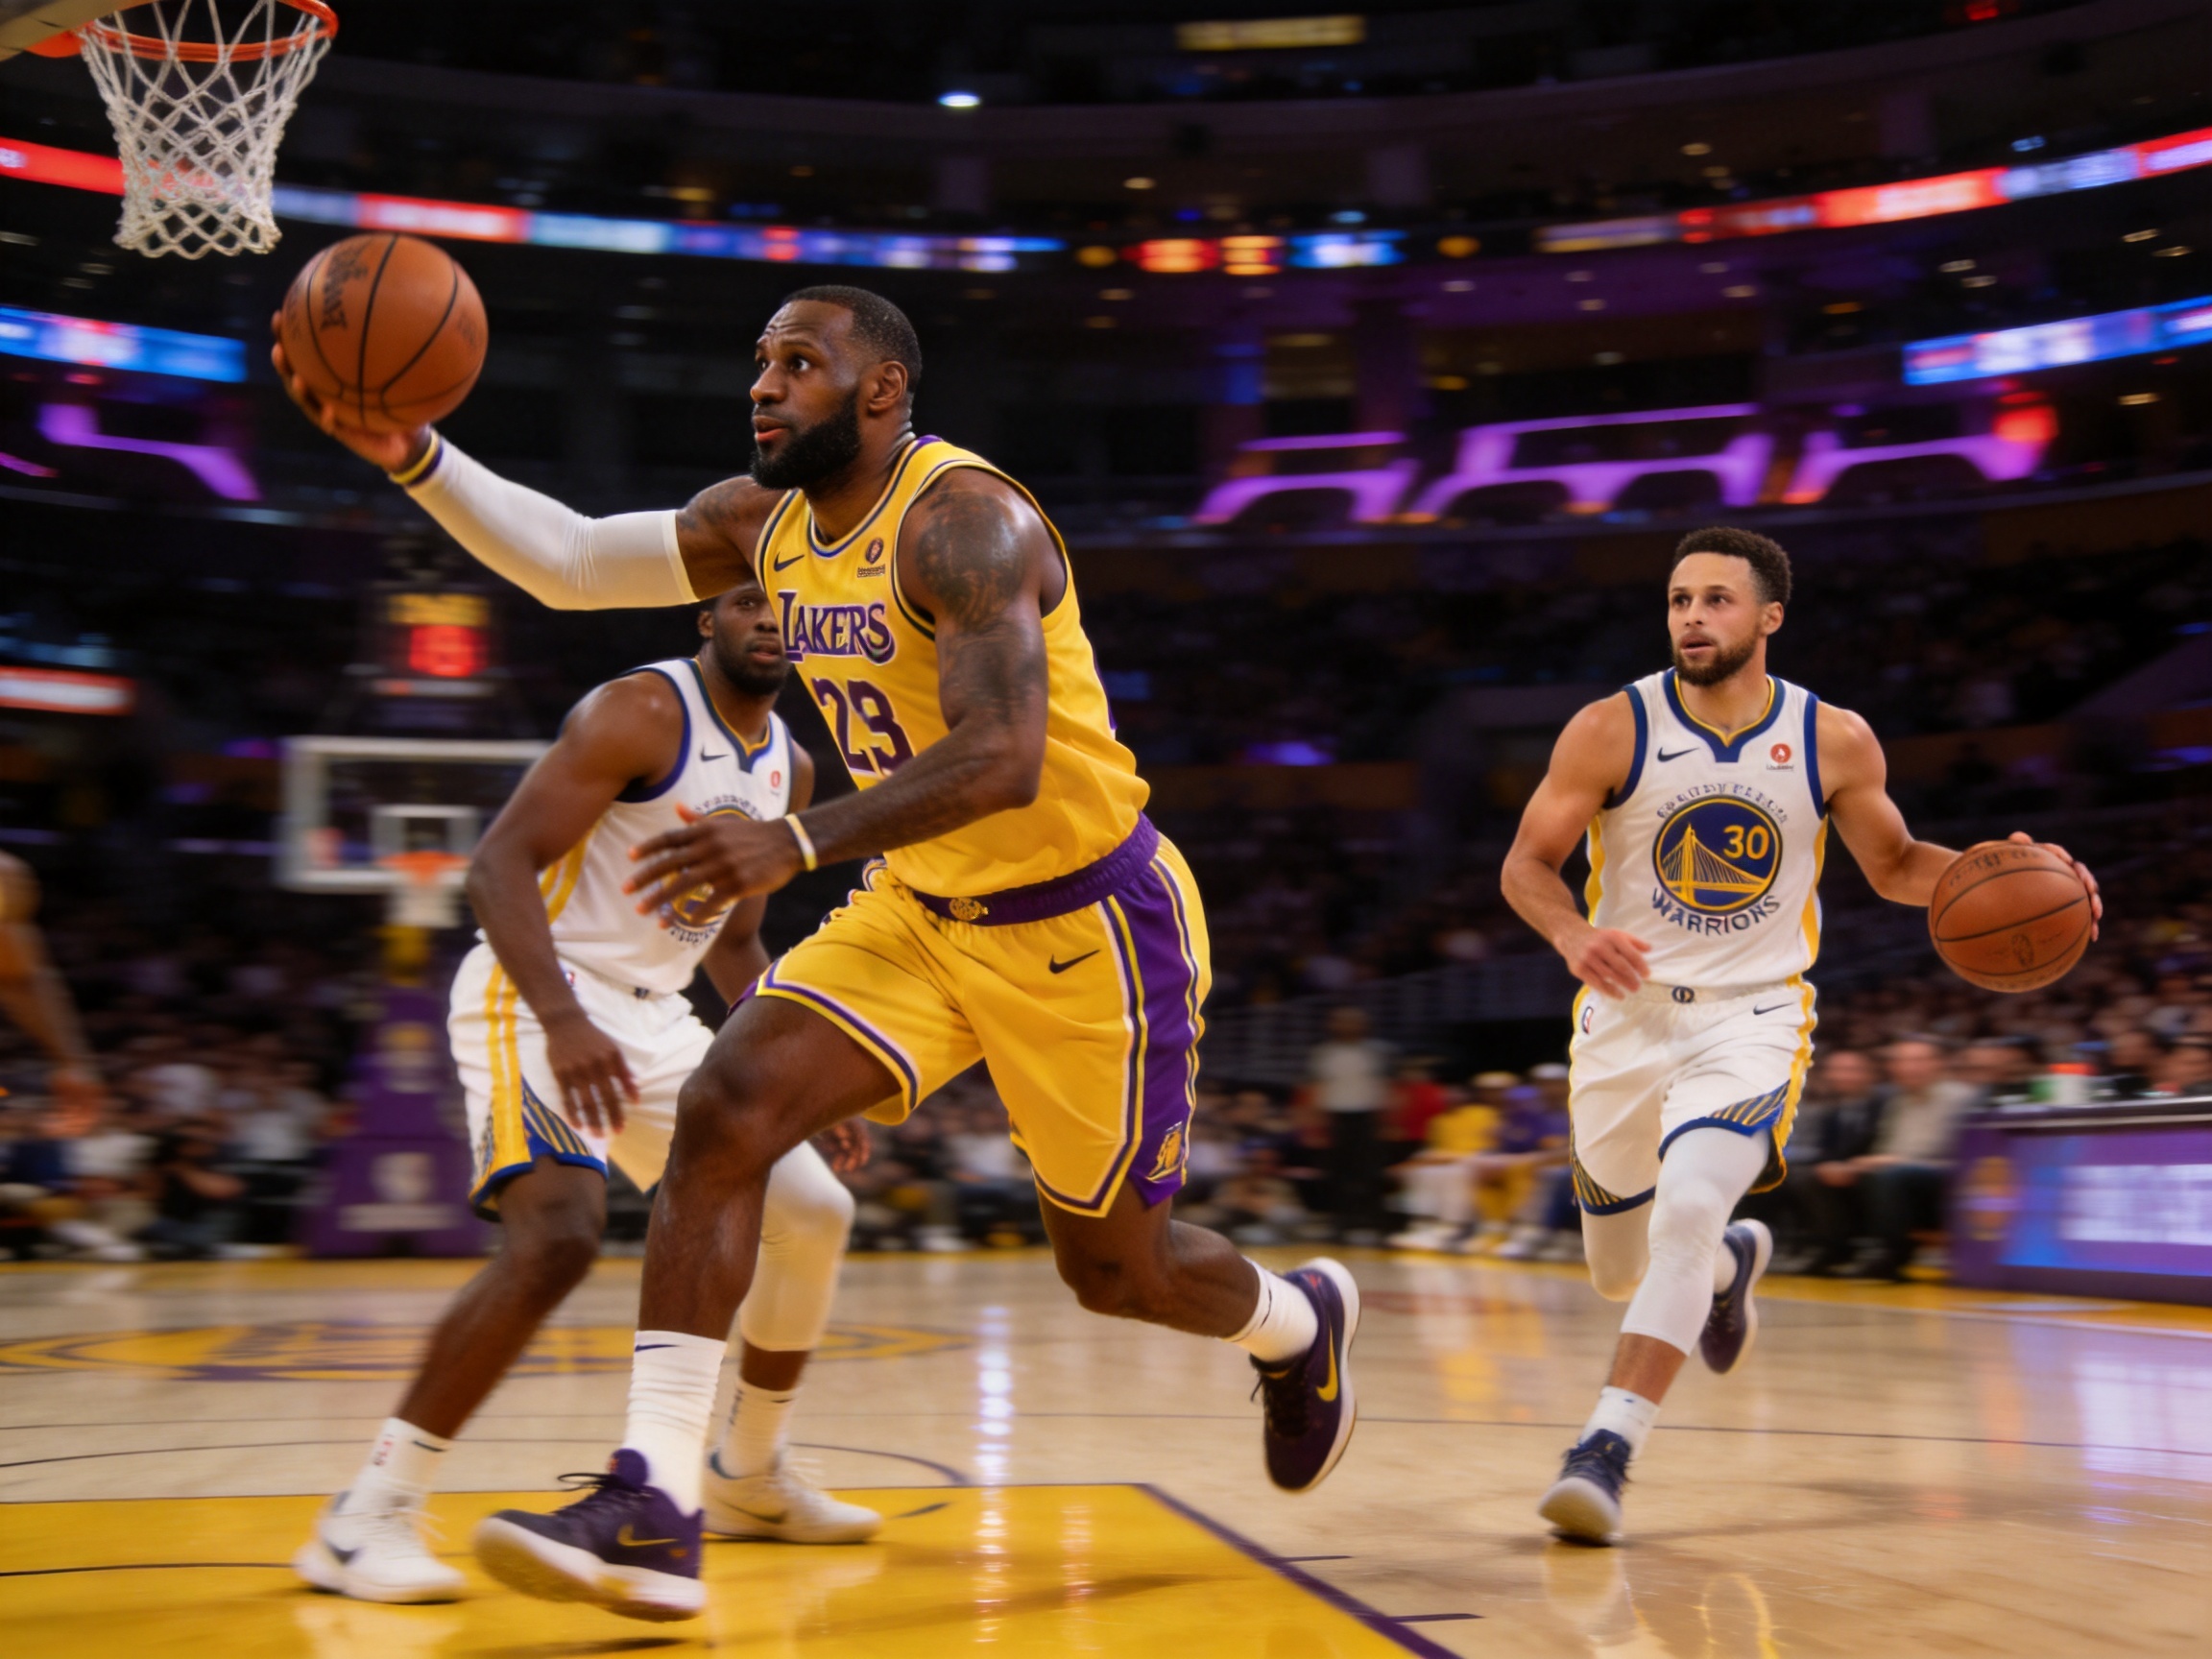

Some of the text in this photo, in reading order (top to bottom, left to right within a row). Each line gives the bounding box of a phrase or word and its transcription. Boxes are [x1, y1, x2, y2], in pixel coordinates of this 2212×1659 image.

[778, 589, 896, 665] LAKERS
[811, 677, 916, 776] 23
[1722, 825, 1770, 860] 30
[1651, 888, 1780, 936] WARRIORS
